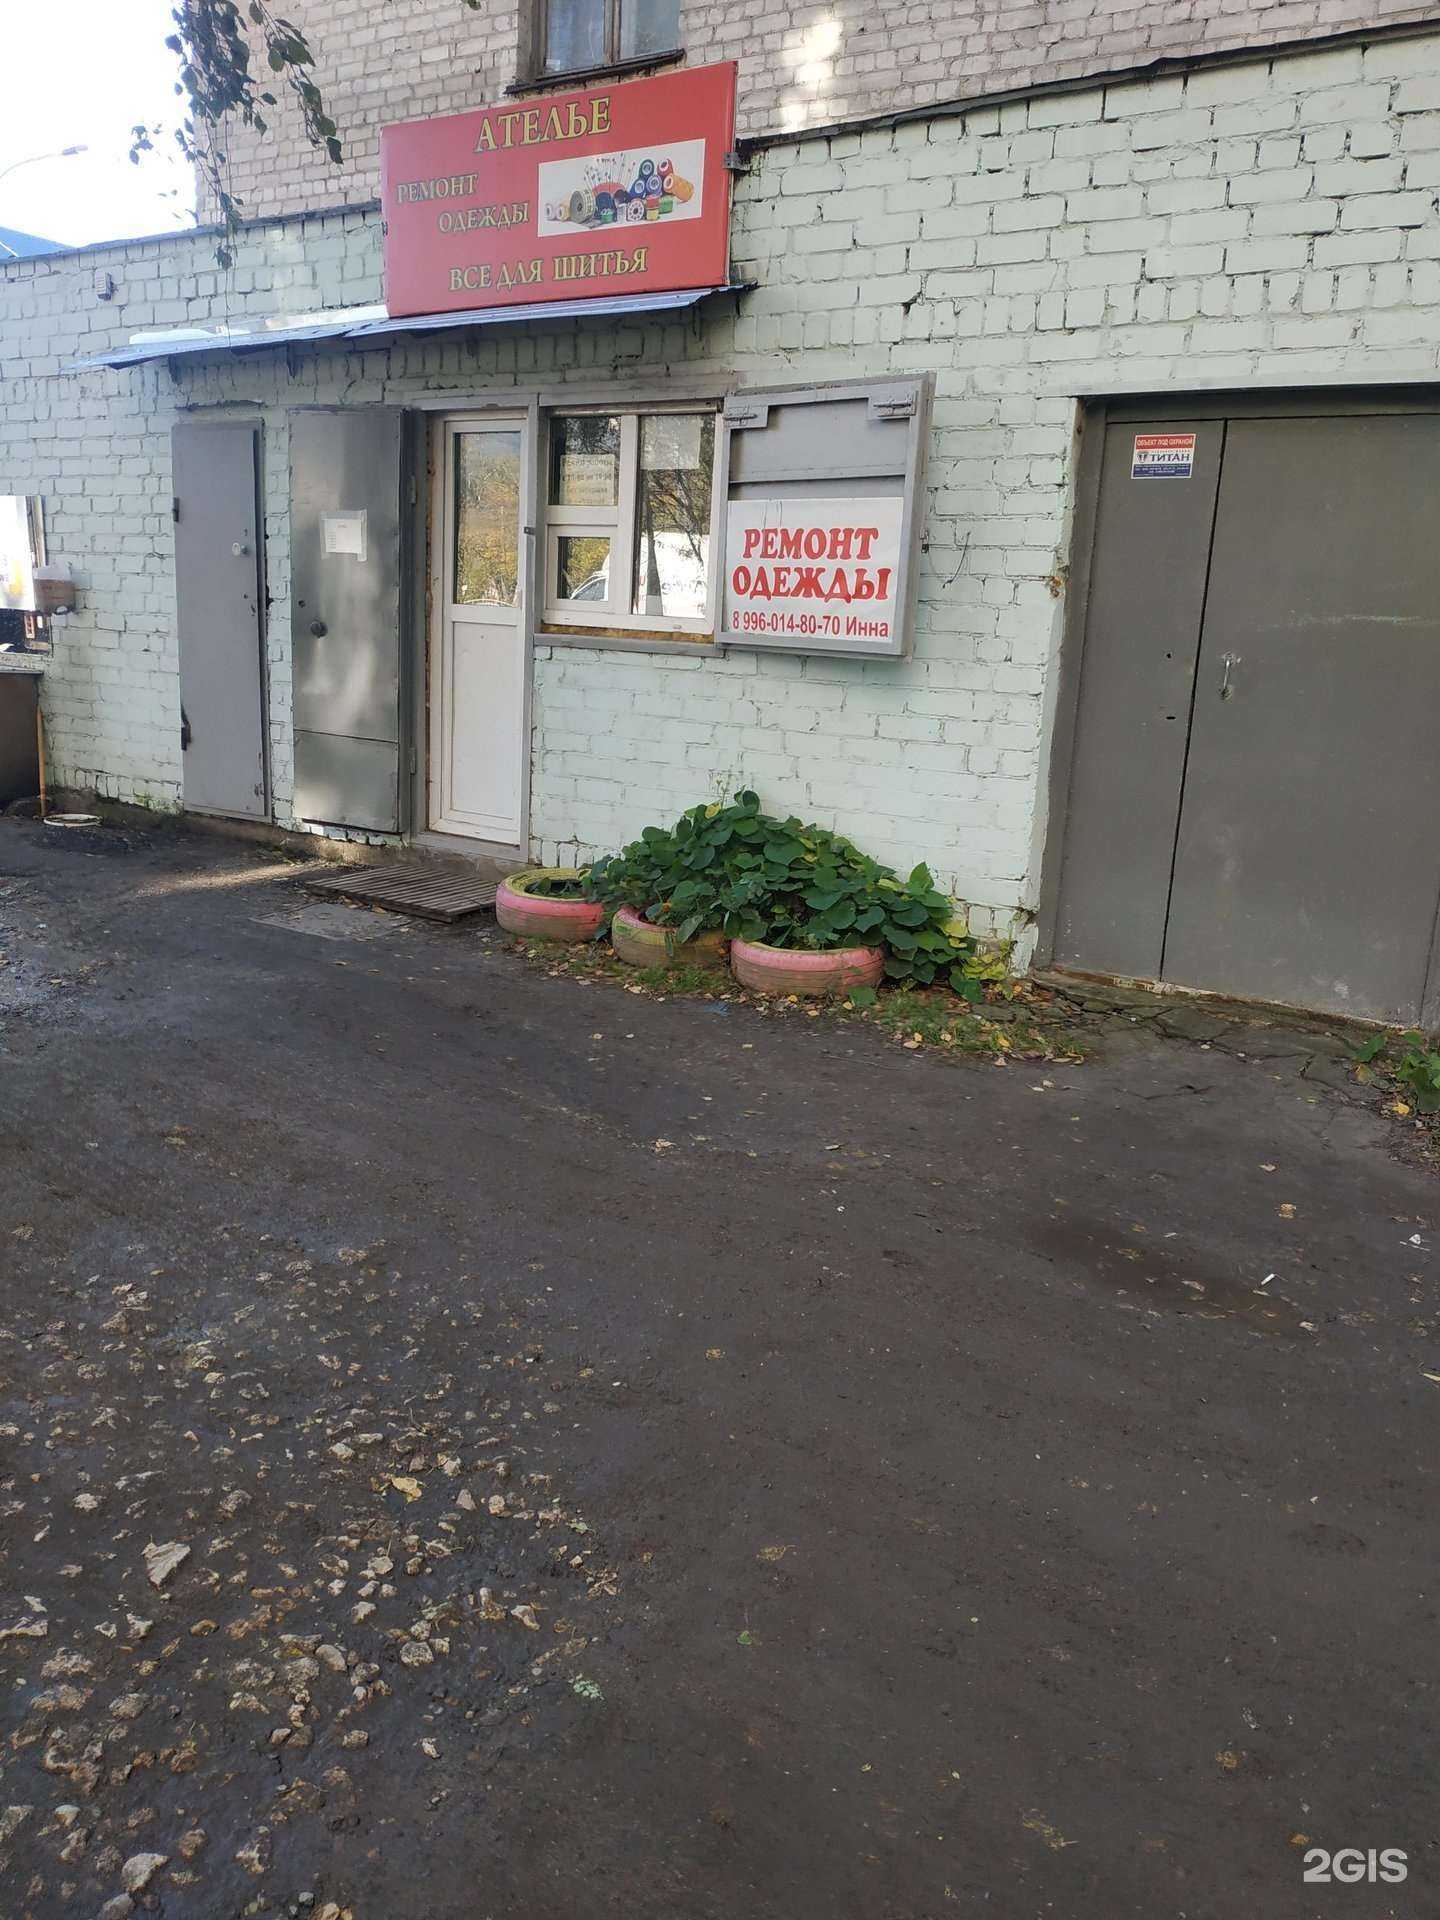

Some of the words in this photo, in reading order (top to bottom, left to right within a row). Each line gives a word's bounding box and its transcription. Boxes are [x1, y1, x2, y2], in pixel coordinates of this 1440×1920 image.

[475, 97, 611, 153] АТЕЛЬЕ
[396, 173, 479, 204] РЕМОНТ
[438, 202, 530, 234] ОДЕЖДЫ
[449, 265, 491, 292] ВСЕ
[496, 259, 543, 291] ДЛЯ
[552, 247, 648, 280] ШИТЬЯ
[1151, 453, 1190, 462] ТИТАН
[743, 528, 879, 560] РЕМОНТ
[732, 565, 892, 603] ОДЕЖДЫ
[732, 610, 740, 629] 8
[743, 611, 840, 635] 996-014-80-70
[845, 616, 889, 638] Инна
